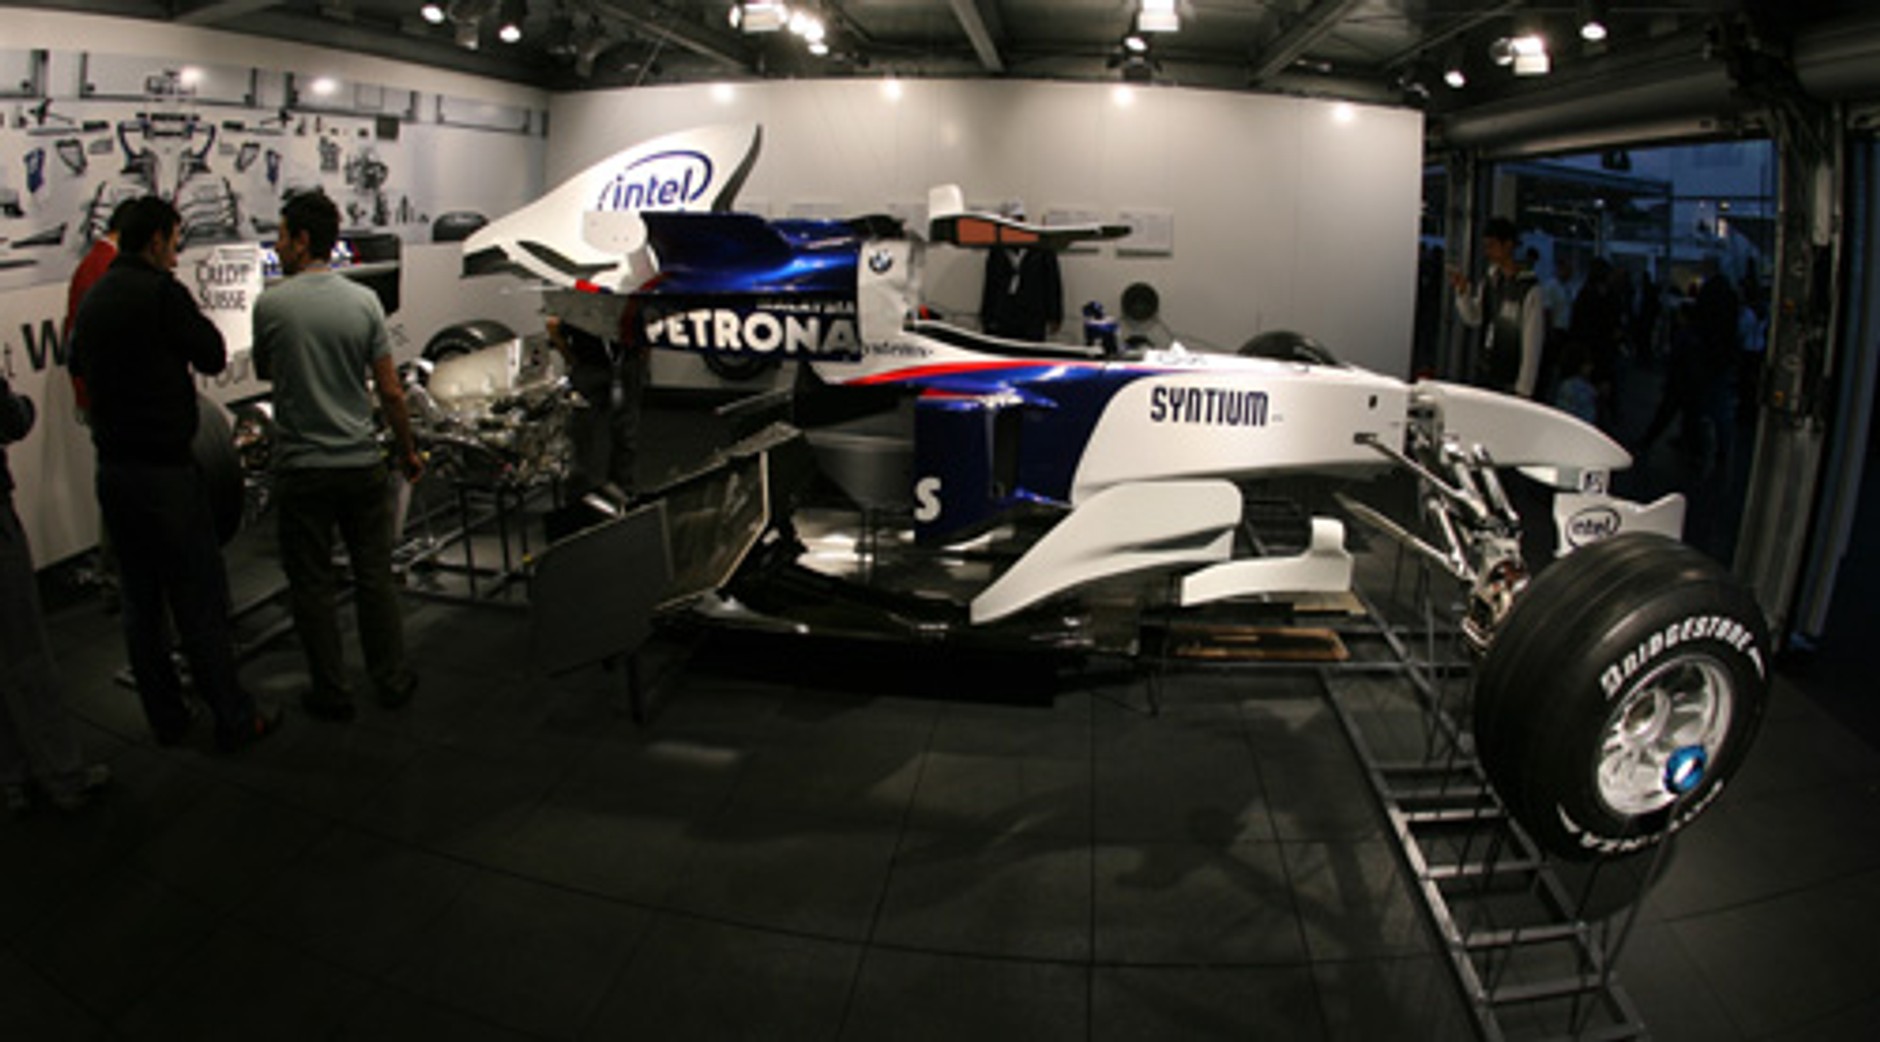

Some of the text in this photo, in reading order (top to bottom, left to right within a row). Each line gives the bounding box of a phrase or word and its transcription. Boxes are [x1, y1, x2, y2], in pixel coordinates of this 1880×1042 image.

[611, 166, 694, 211] intel
[1149, 385, 1270, 428] SYNTIUM
[914, 476, 942, 521] S
[1600, 616, 1754, 700] BRIDGESTONE
